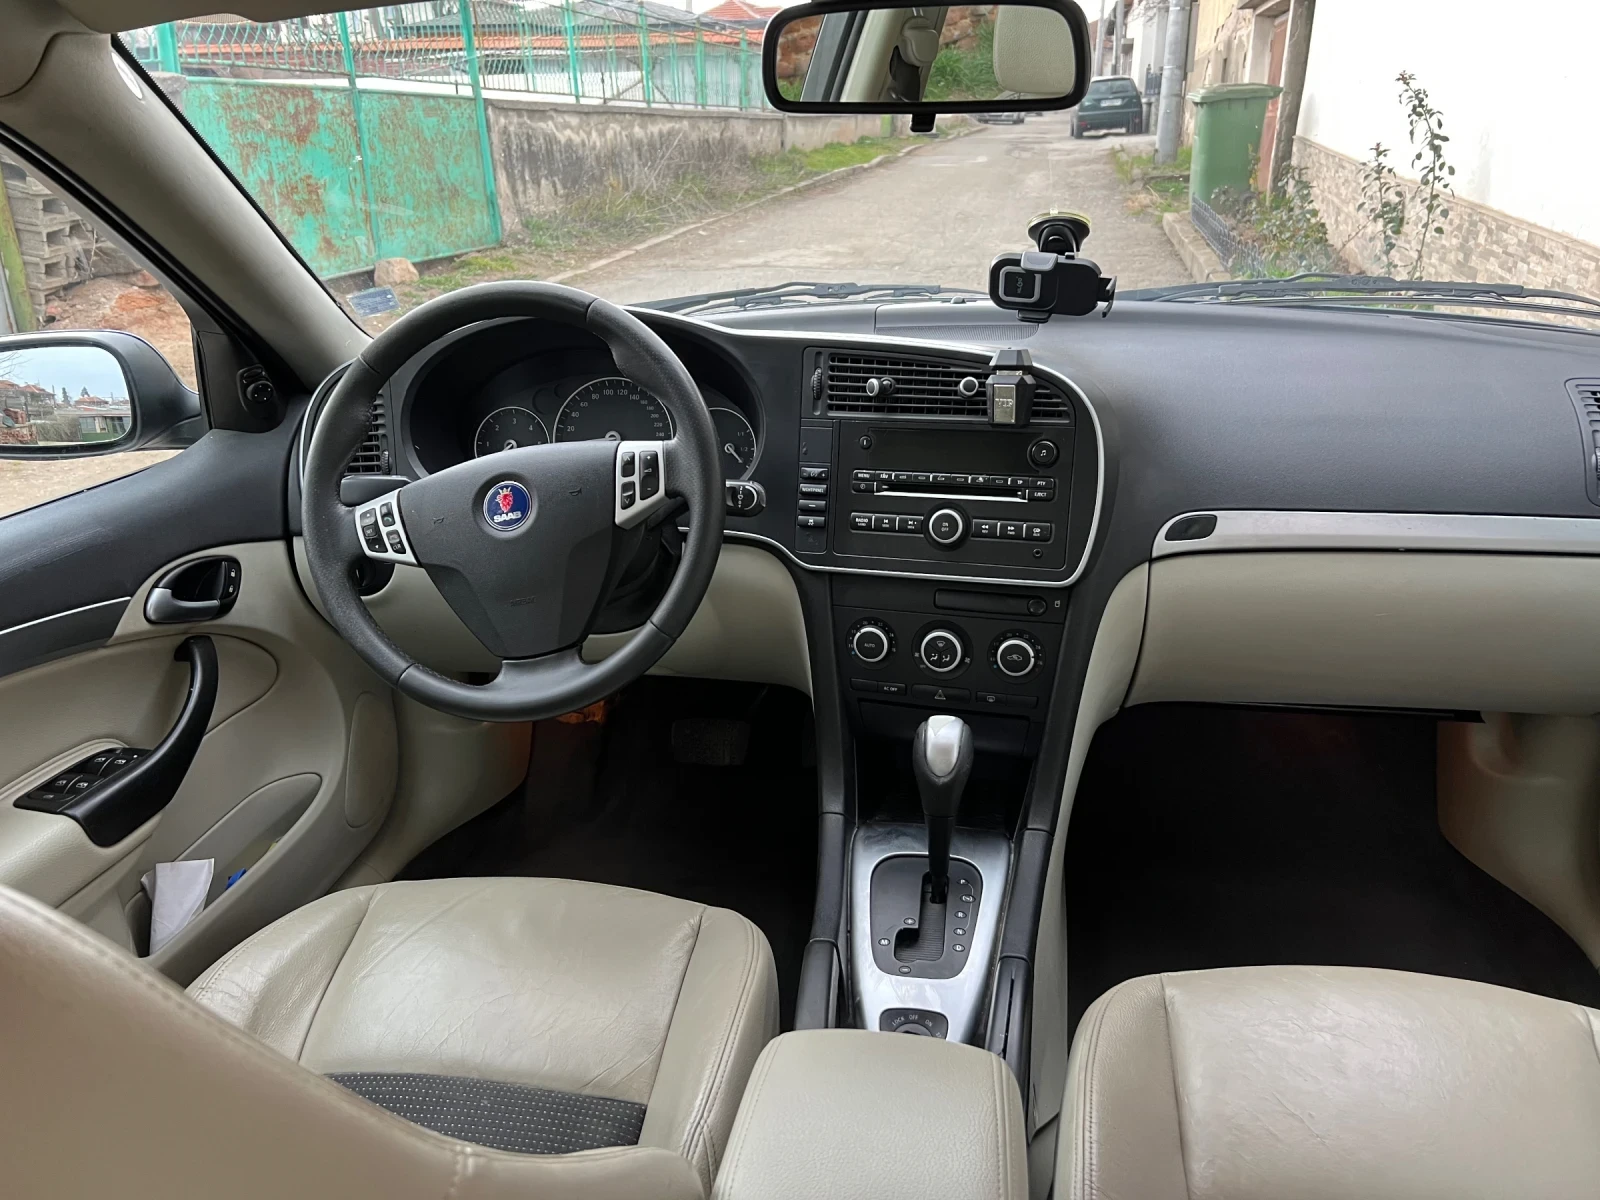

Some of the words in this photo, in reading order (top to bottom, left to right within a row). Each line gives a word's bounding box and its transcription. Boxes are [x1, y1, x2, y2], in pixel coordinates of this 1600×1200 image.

[995, 399, 1013, 408] VIP
[494, 511, 522, 522] SAAB
[892, 1016, 905, 1026] LOCK
[925, 1019, 934, 1027] ON
